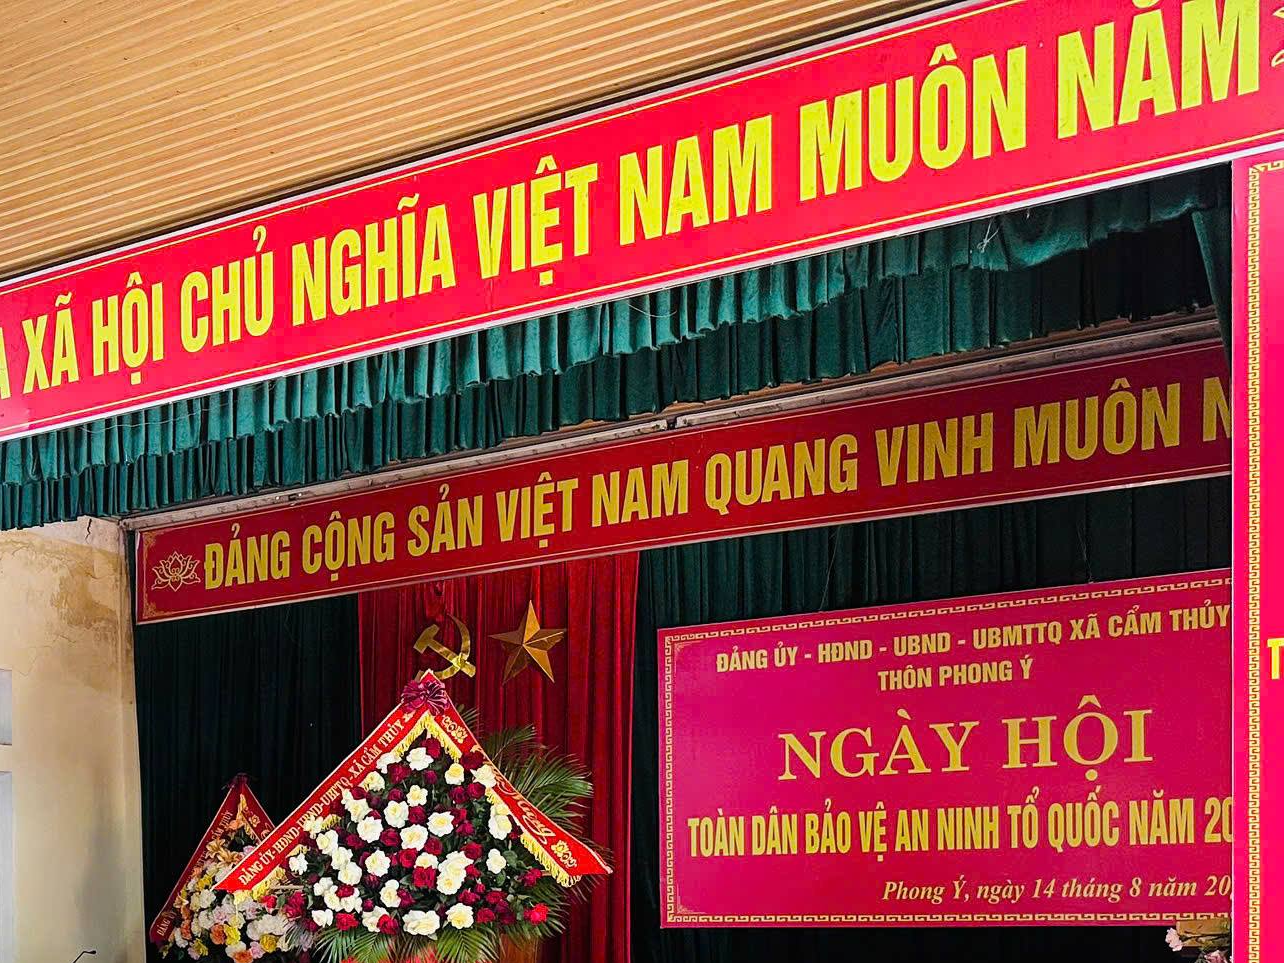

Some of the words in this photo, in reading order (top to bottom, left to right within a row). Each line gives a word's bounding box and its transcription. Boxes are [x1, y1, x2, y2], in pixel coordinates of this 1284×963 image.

[22, 292, 79, 393] XÃ
[92, 272, 164, 385] HỘI
[181, 225, 274, 353] CHỦ
[292, 194, 456, 327] NGHĨA
[473, 156, 598, 287] VIỆT
[619, 115, 773, 247] NAM
[800, 43, 1026, 202] MUÔN
[204, 523, 291, 590] ĐẢNG
[302, 511, 395, 581] CỘNG
[407, 484, 483, 554] SẢN
[496, 471, 579, 547] VIỆT
[591, 461, 689, 528] NAM
[704, 433, 858, 515] QUANG
[875, 411, 993, 487] VINH
[1014, 378, 1181, 469] MUÔN
[716, 645, 768, 674] ĐẢNG
[774, 641, 798, 668] ỦY
[818, 639, 873, 664] HĐND
[893, 632, 951, 657] UBND
[972, 621, 1062, 650] UBMTTQ
[1069, 612, 1101, 641] XÃ
[1108, 604, 1161, 637] CẨM
[1169, 599, 1230, 632] THỦY
[878, 665, 932, 691] THÔN
[939, 660, 1013, 687] PHONG
[1020, 655, 1033, 680] Ý
[777, 708, 980, 781] NGÀY
[1001, 694, 1153, 782] HỘI
[688, 808, 745, 857] TOÀN
[752, 805, 798, 856] DÂN
[805, 798, 852, 854] BẢO
[858, 801, 887, 862] VỆ
[895, 809, 929, 852] AN
[937, 806, 1000, 851] NINH
[1007, 785, 1039, 849] TỔ
[1047, 785, 1119, 853] QUỐC
[1129, 789, 1195, 846] NĂM
[238, 861, 264, 885] ĐẢNG
[882, 880, 944, 904] Phong
[952, 874, 970, 902] Ý,
[977, 879, 1025, 904] ngày
[1033, 877, 1055, 899] 14
[1061, 877, 1123, 904] tháng
[1130, 876, 1142, 898] 8
[1149, 877, 1197, 897] năm
